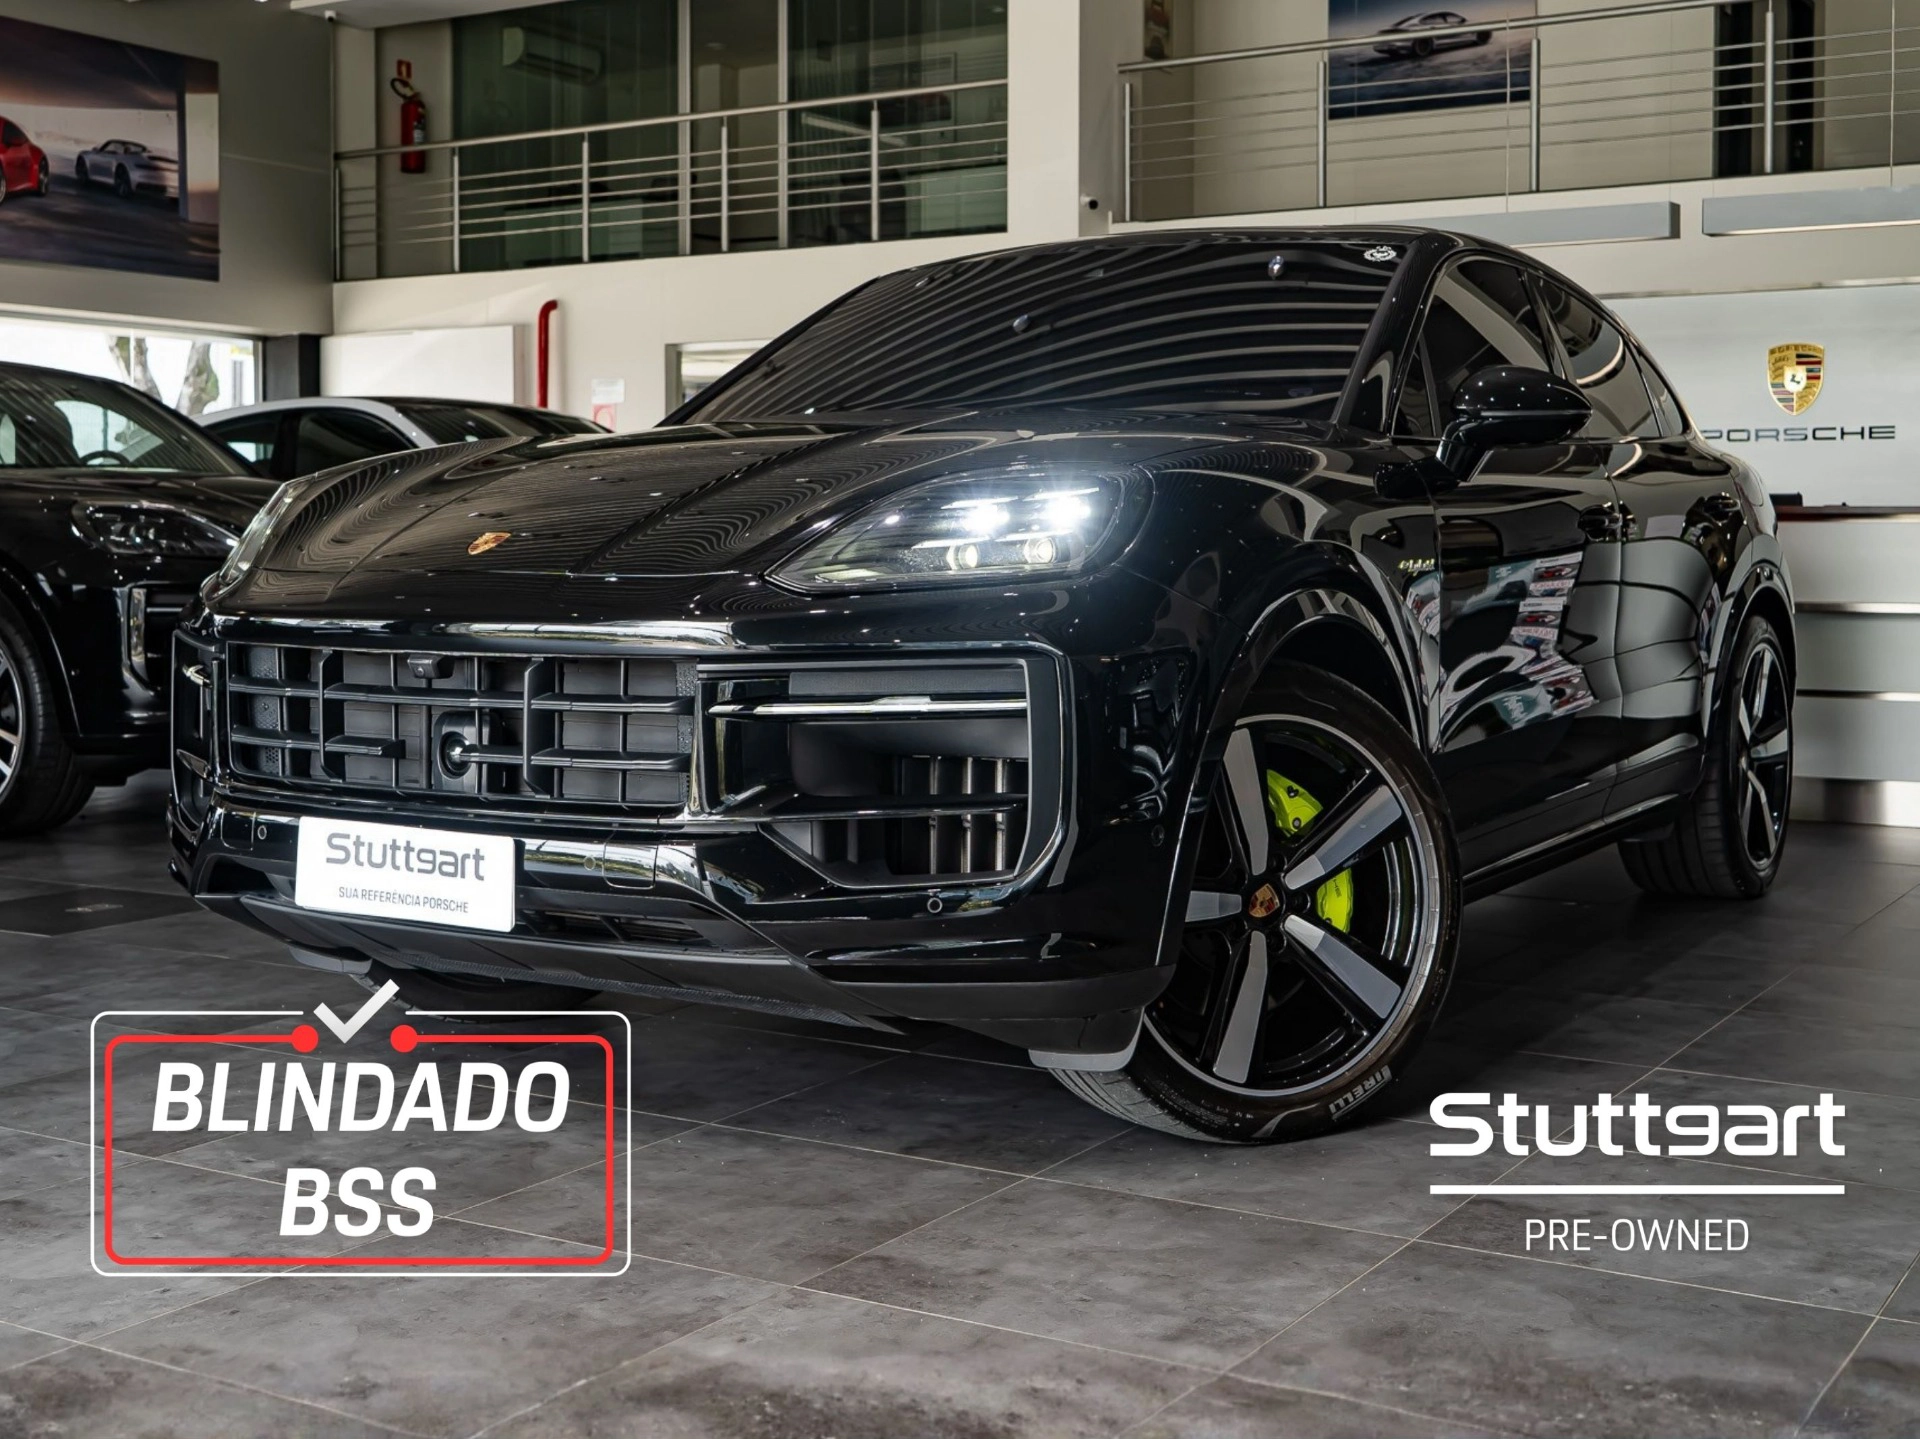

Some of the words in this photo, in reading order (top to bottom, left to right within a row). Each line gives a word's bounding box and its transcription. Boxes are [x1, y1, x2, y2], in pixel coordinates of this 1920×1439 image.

[1701, 425, 1896, 442] PORSCHE
[326, 832, 485, 881] Stuttgart
[339, 886, 359, 899] SUA
[422, 896, 469, 913] PORSCHE
